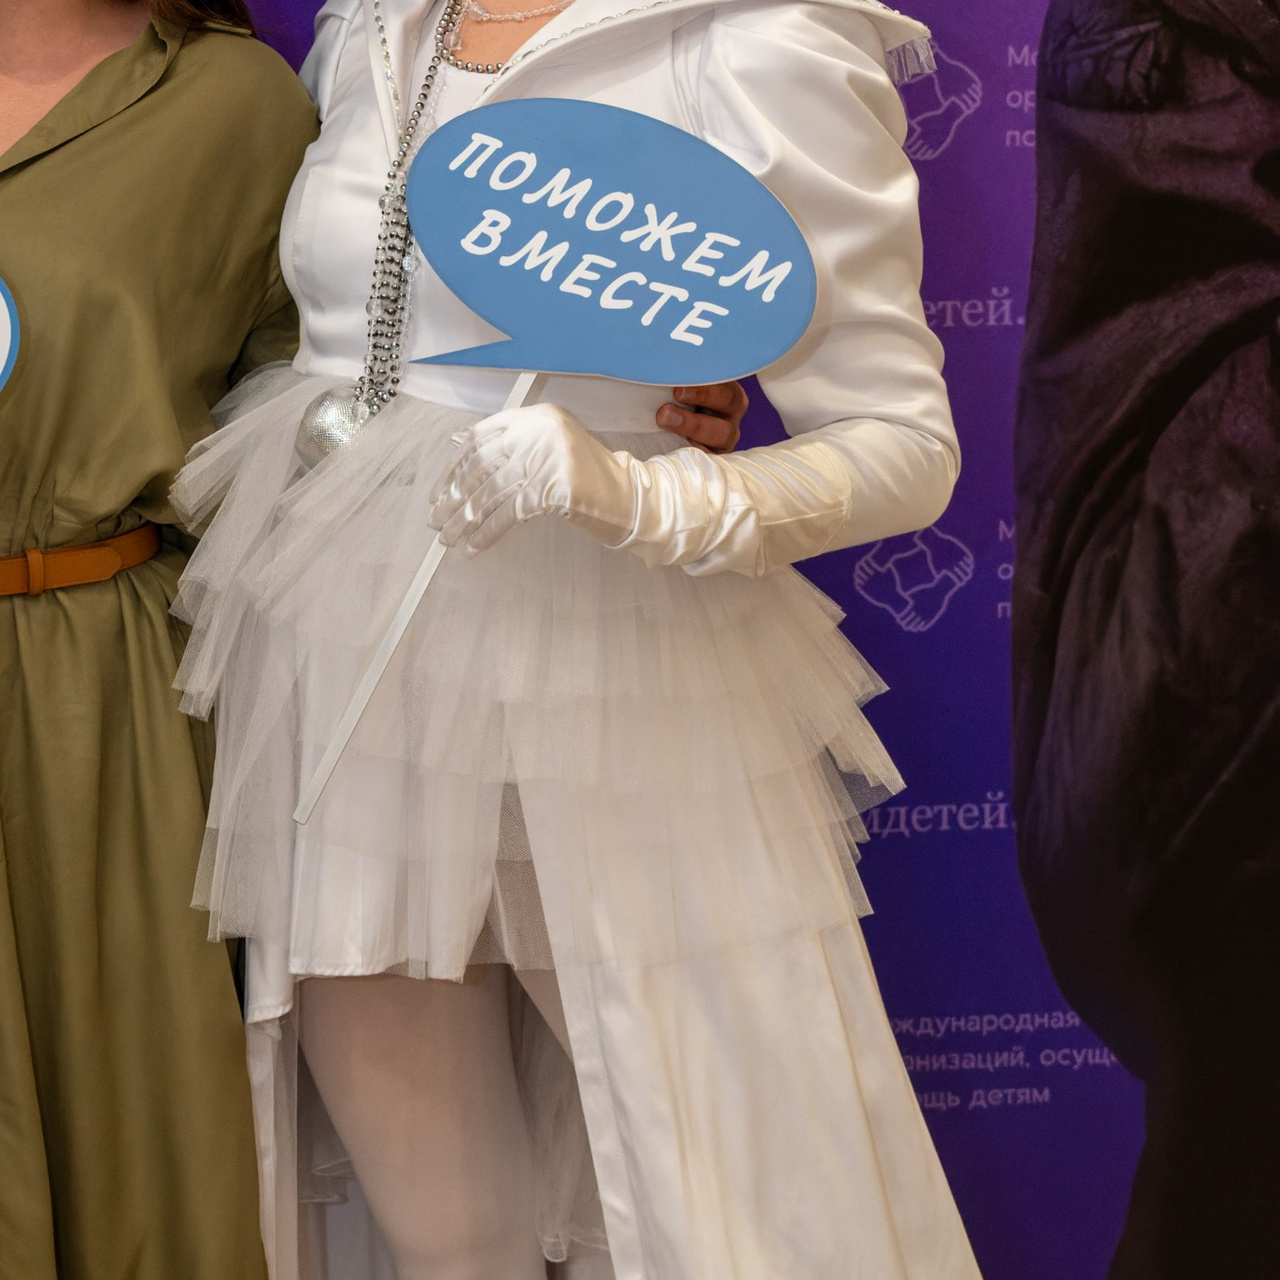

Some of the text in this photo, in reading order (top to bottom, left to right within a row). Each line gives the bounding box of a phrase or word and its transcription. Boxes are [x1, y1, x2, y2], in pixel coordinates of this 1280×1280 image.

[448, 132, 793, 303] ПОМОЖЕМ
[460, 209, 729, 346] ВМЕСТЕ
[891, 1010, 1080, 1037] ждународная
[1039, 1047, 1118, 1070] осущ
[968, 1085, 1052, 1111] детям
